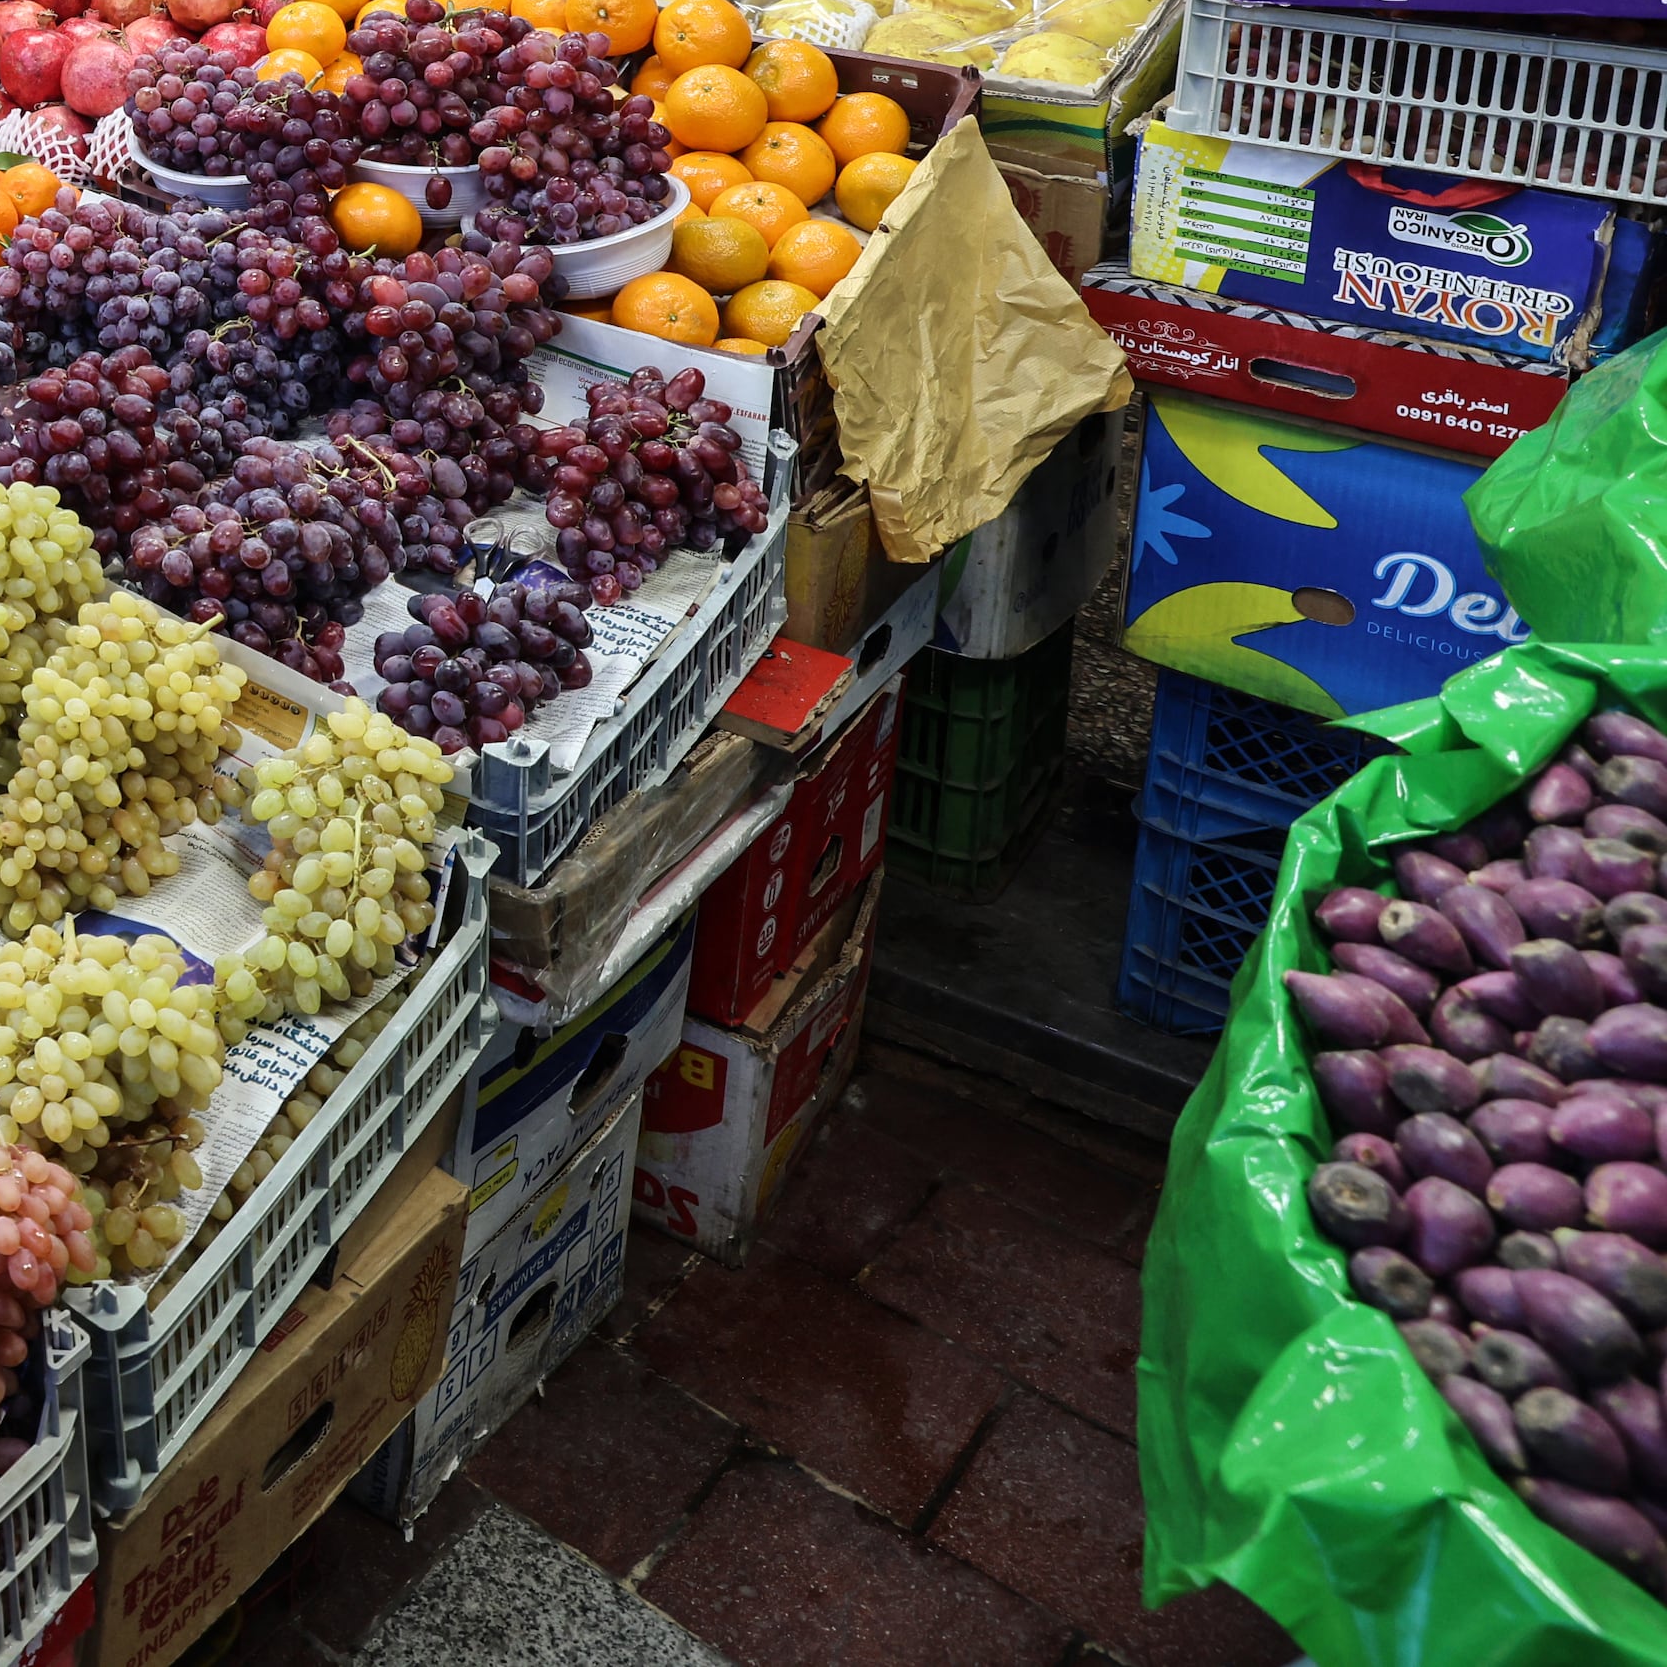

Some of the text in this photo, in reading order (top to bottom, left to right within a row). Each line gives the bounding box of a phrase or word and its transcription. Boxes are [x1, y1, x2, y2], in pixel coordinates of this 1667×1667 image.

[1395, 208, 1428, 223] IRAN
[1451, 241, 1483, 253] PRODUTO
[1334, 249, 1571, 315] GREENHOUSE
[1334, 271, 1559, 348] ROYAN
[1110, 332, 1240, 374] انار کوهستان دارا
[1396, 404, 1442, 425] 0991
[1445, 414, 1484, 433] 640
[1420, 388, 1510, 415] اصغر باقری
[586, 611, 629, 633] سرمایه
[616, 636, 653, 651] اجرای
[1367, 621, 1483, 663] DELICIOUS
[245, 1031, 308, 1069] جذب سرما
[274, 1026, 325, 1057] انشگاه
[239, 1069, 279, 1092] دانش
[257, 1058, 298, 1081] اجرای
[522, 1062, 641, 1192] PREMIUM PACK
[490, 1220, 581, 1317] FRESH BANANAS
[445, 1379, 455, 1396] 5
[161, 1474, 220, 1547] Dole
[123, 1478, 246, 1619] Tropical
[138, 1540, 219, 1633] Gold
